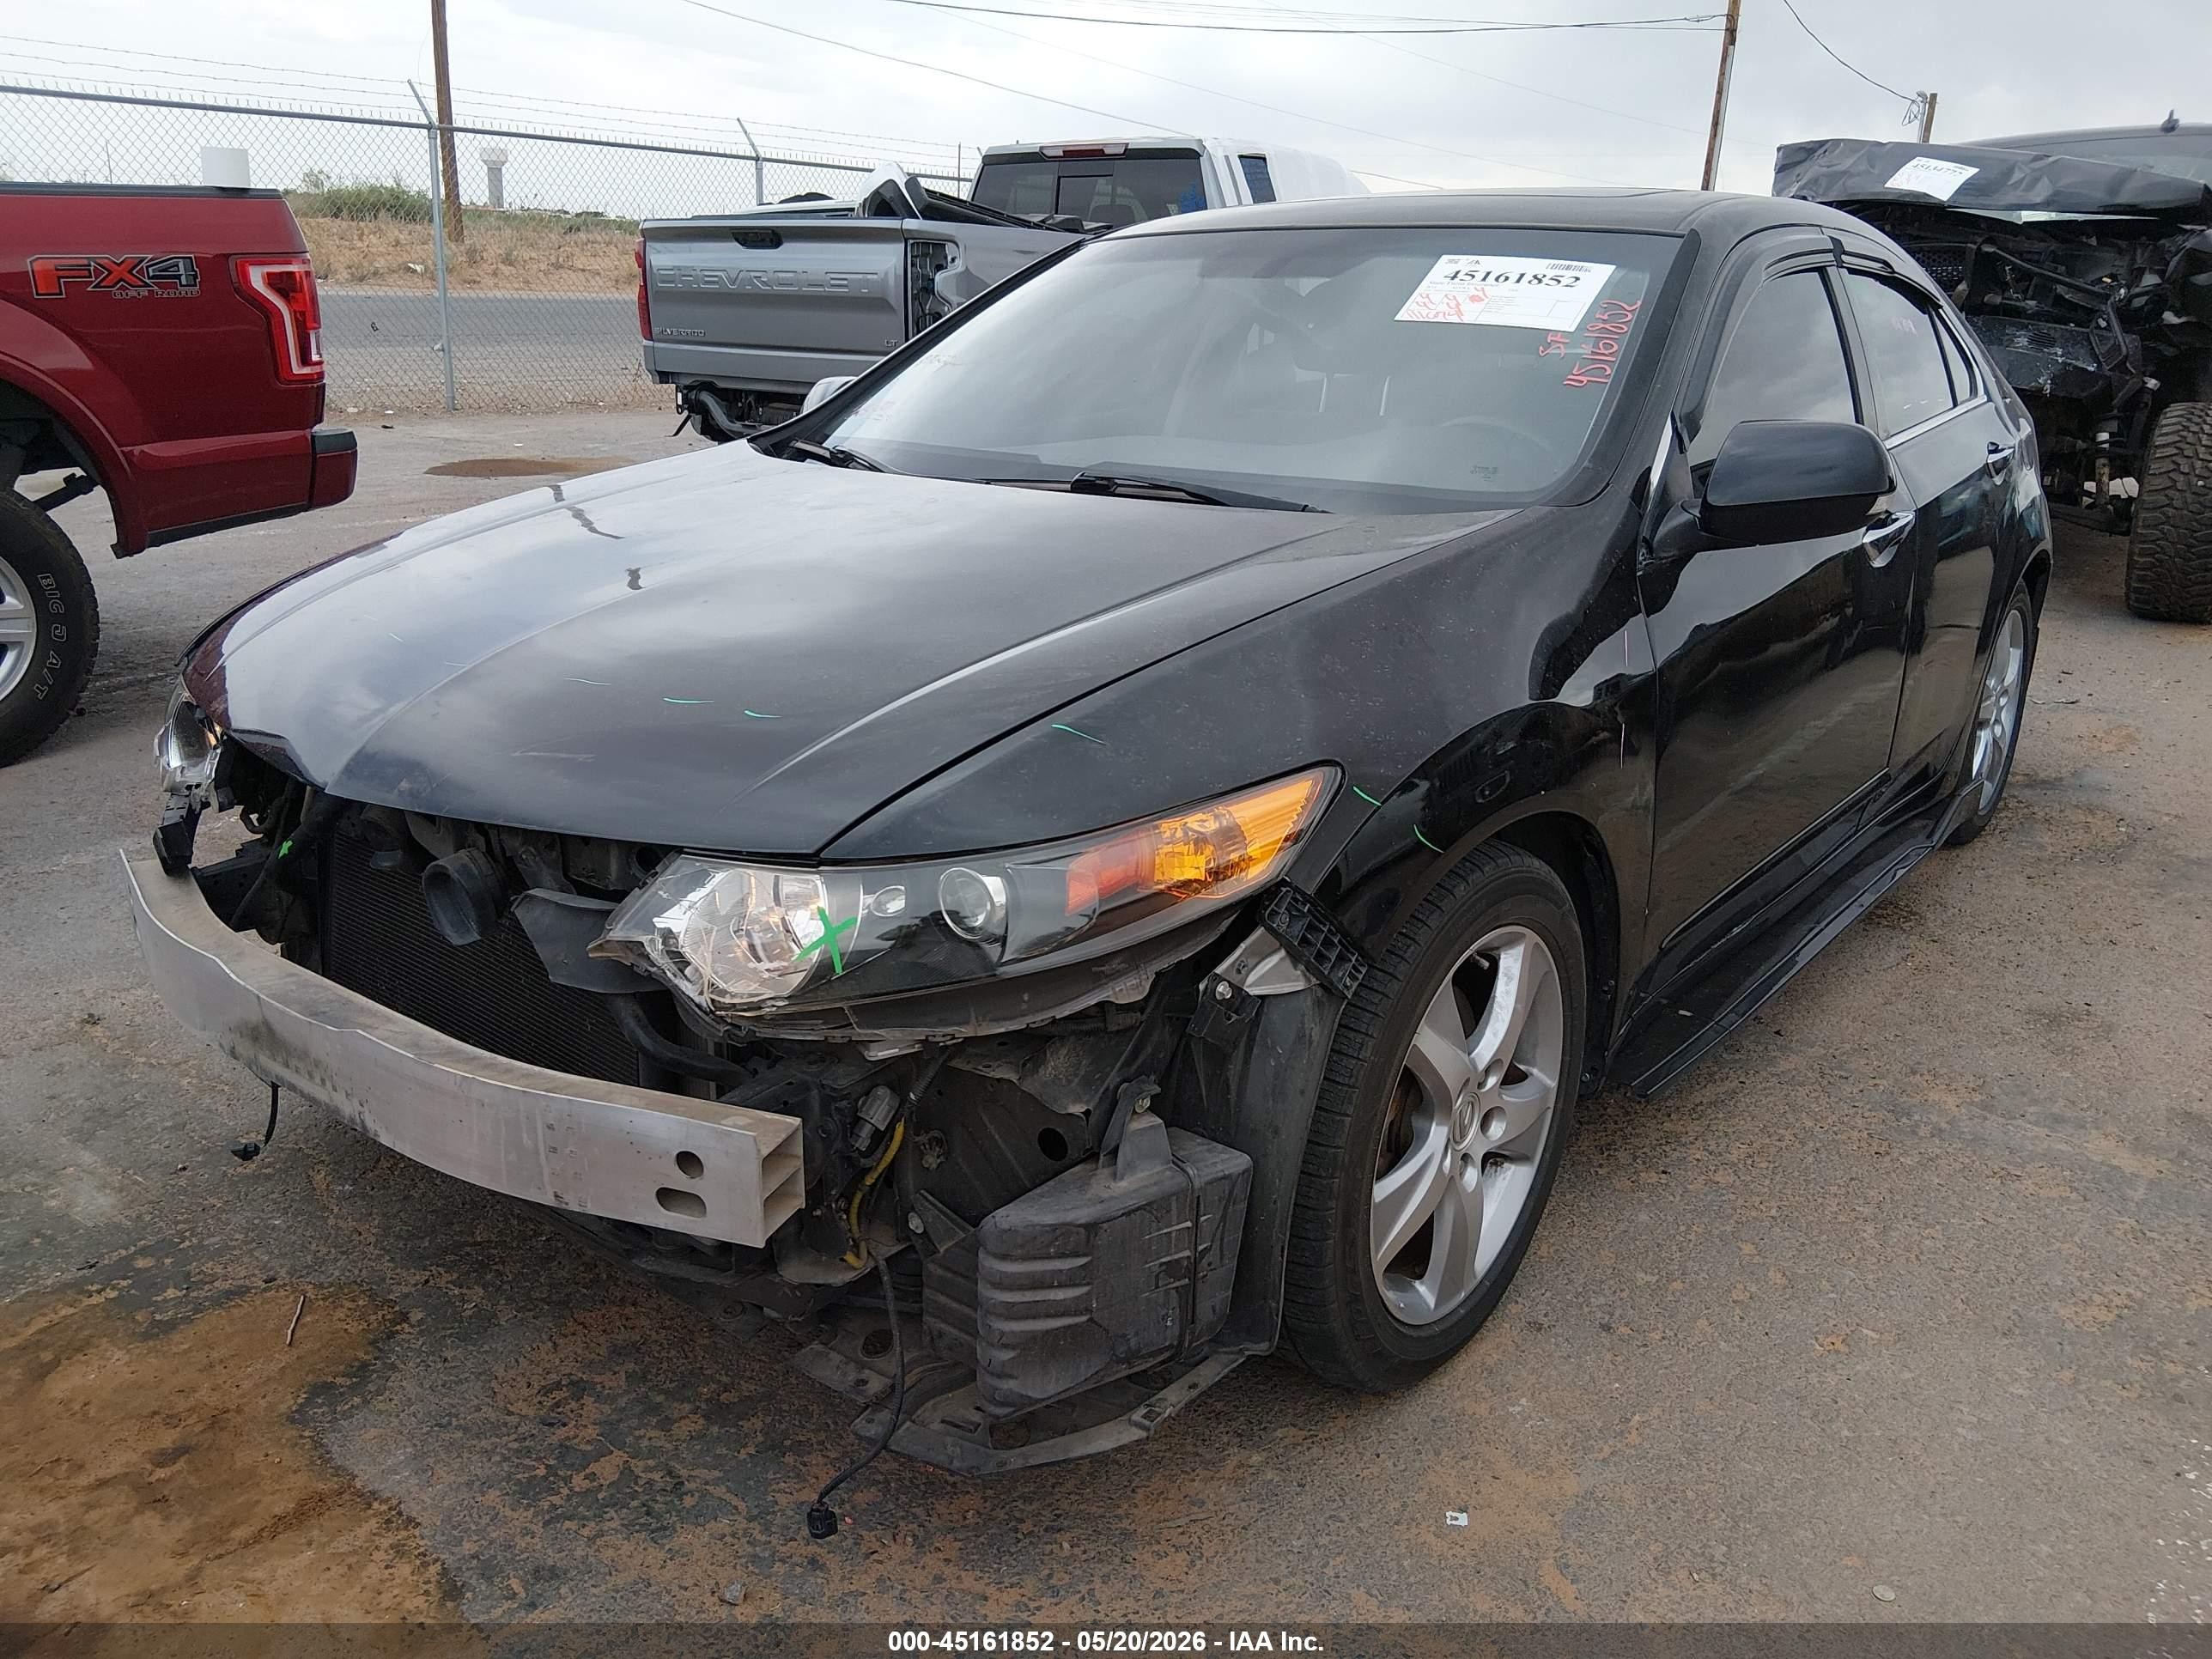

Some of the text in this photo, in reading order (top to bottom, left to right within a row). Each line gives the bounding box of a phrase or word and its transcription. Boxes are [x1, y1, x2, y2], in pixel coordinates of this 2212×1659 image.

[27, 255, 200, 298] FX4
[112, 289, 200, 299] OFF ROAD
[657, 268, 878, 293] CHEVROLET
[1443, 269, 1581, 288] 45161852
[1562, 300, 1642, 387] 45161852
[37, 573, 65, 614] BIG
[33, 649, 62, 700] A/T
